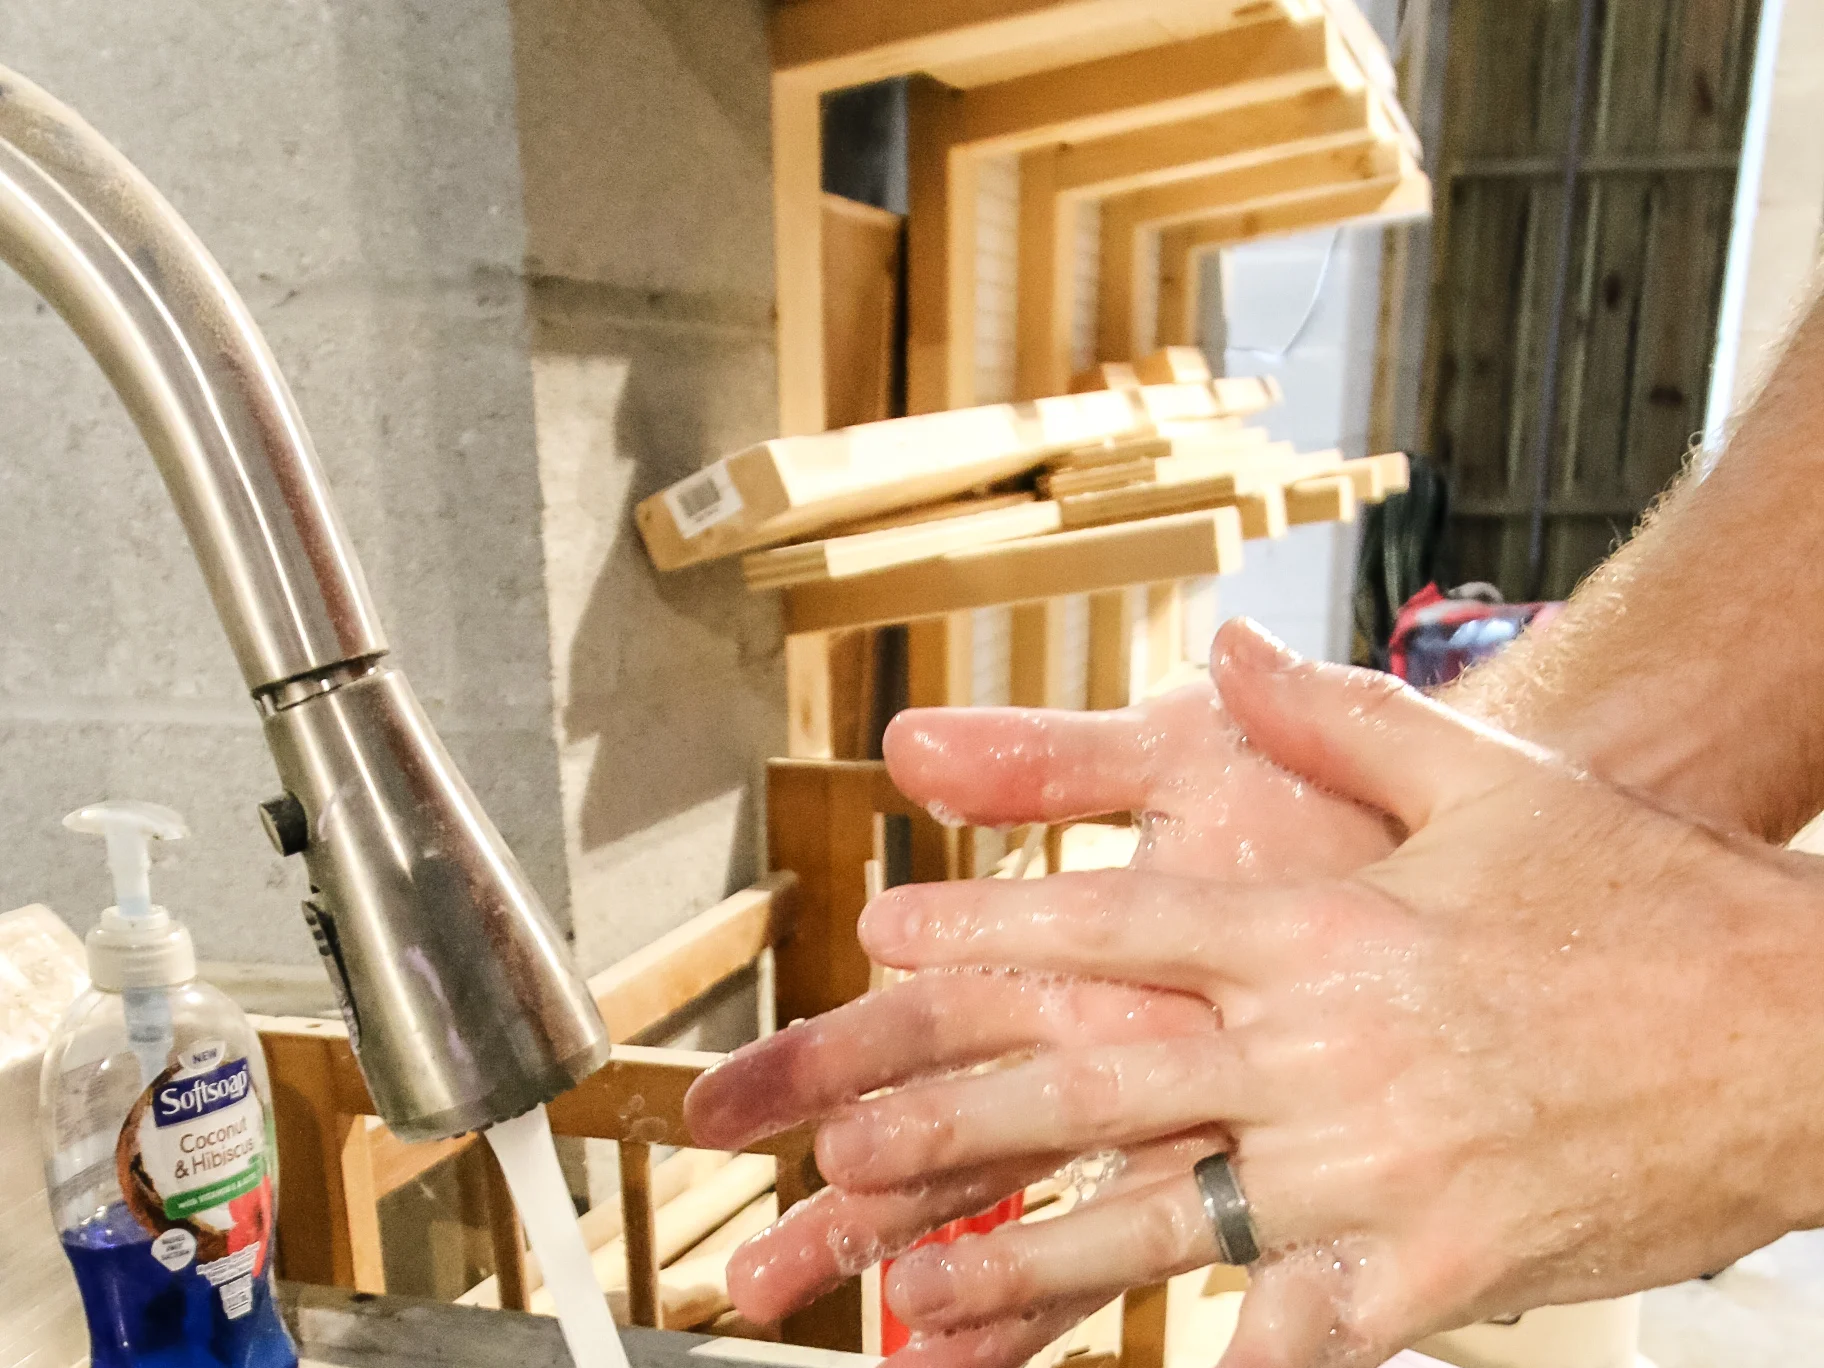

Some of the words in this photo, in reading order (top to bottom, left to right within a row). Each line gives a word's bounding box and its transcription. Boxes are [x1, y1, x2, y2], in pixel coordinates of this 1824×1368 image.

[192, 1048, 217, 1064] NEW
[160, 1070, 248, 1115] Softsoap
[180, 1117, 248, 1154] Coconut
[174, 1160, 190, 1180] &
[192, 1138, 254, 1175] Hibiscus
